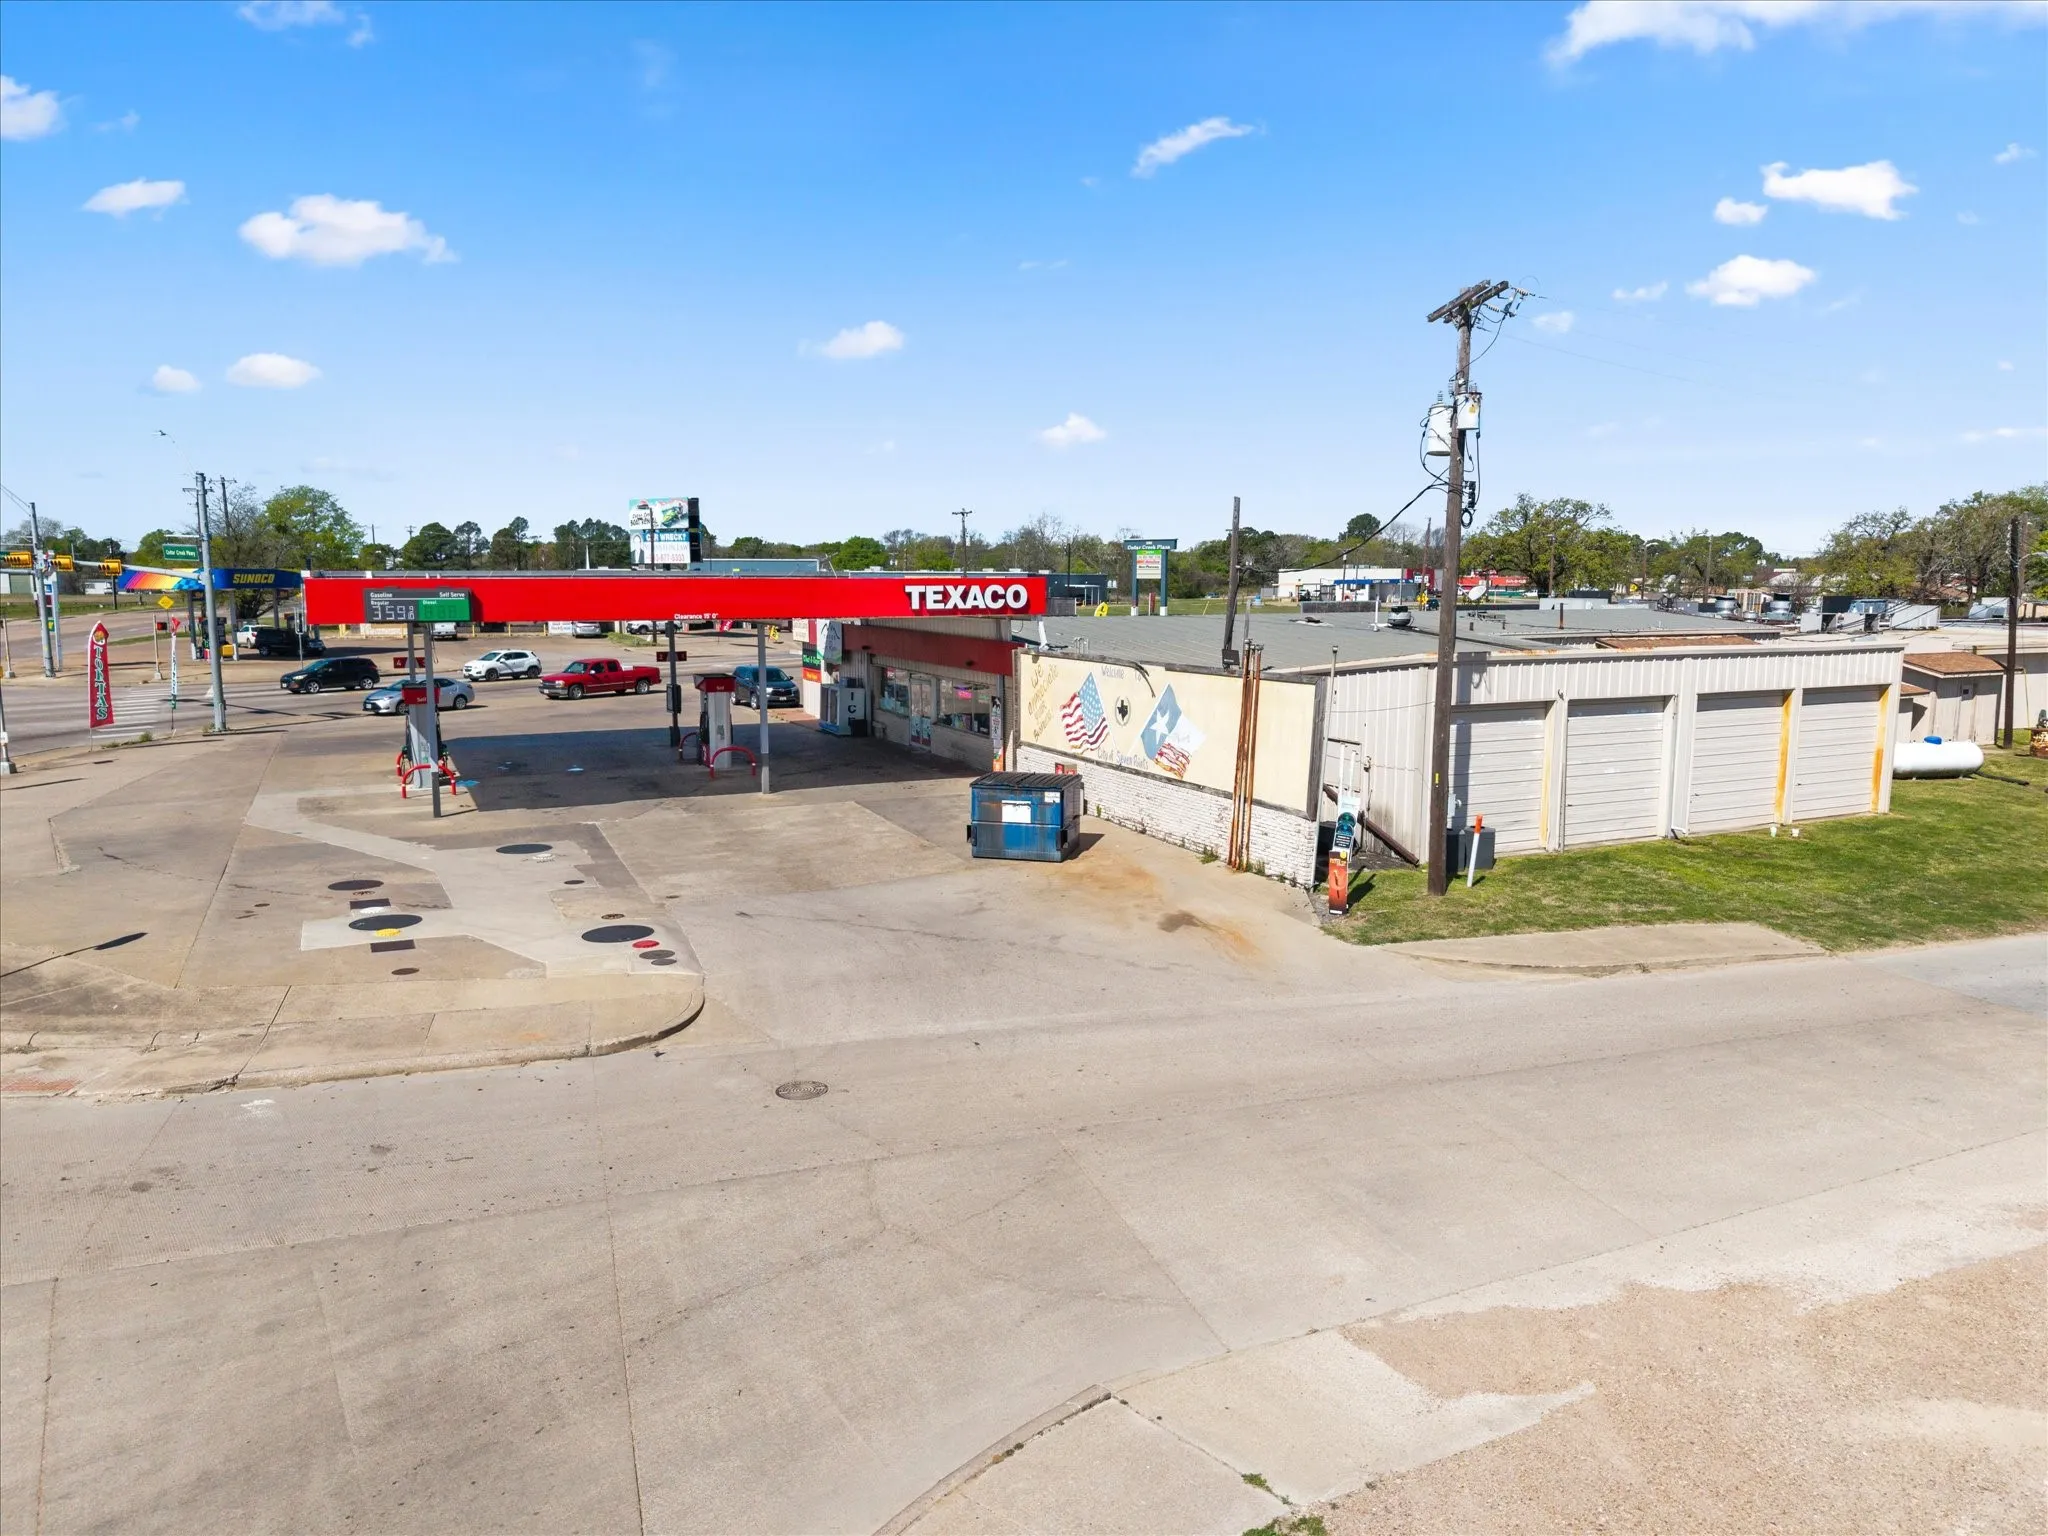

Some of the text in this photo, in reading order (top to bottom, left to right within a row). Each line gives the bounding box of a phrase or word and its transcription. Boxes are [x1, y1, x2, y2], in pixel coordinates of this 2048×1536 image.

[645, 533, 686, 541] CR WRECK?
[232, 573, 276, 584] SUNOCO
[904, 584, 1029, 610] TEXACO
[1101, 665, 1125, 680] Welcome
[1097, 747, 1108, 760] City
[1116, 750, 1133, 765] Seven
[1133, 754, 1149, 770] Points
